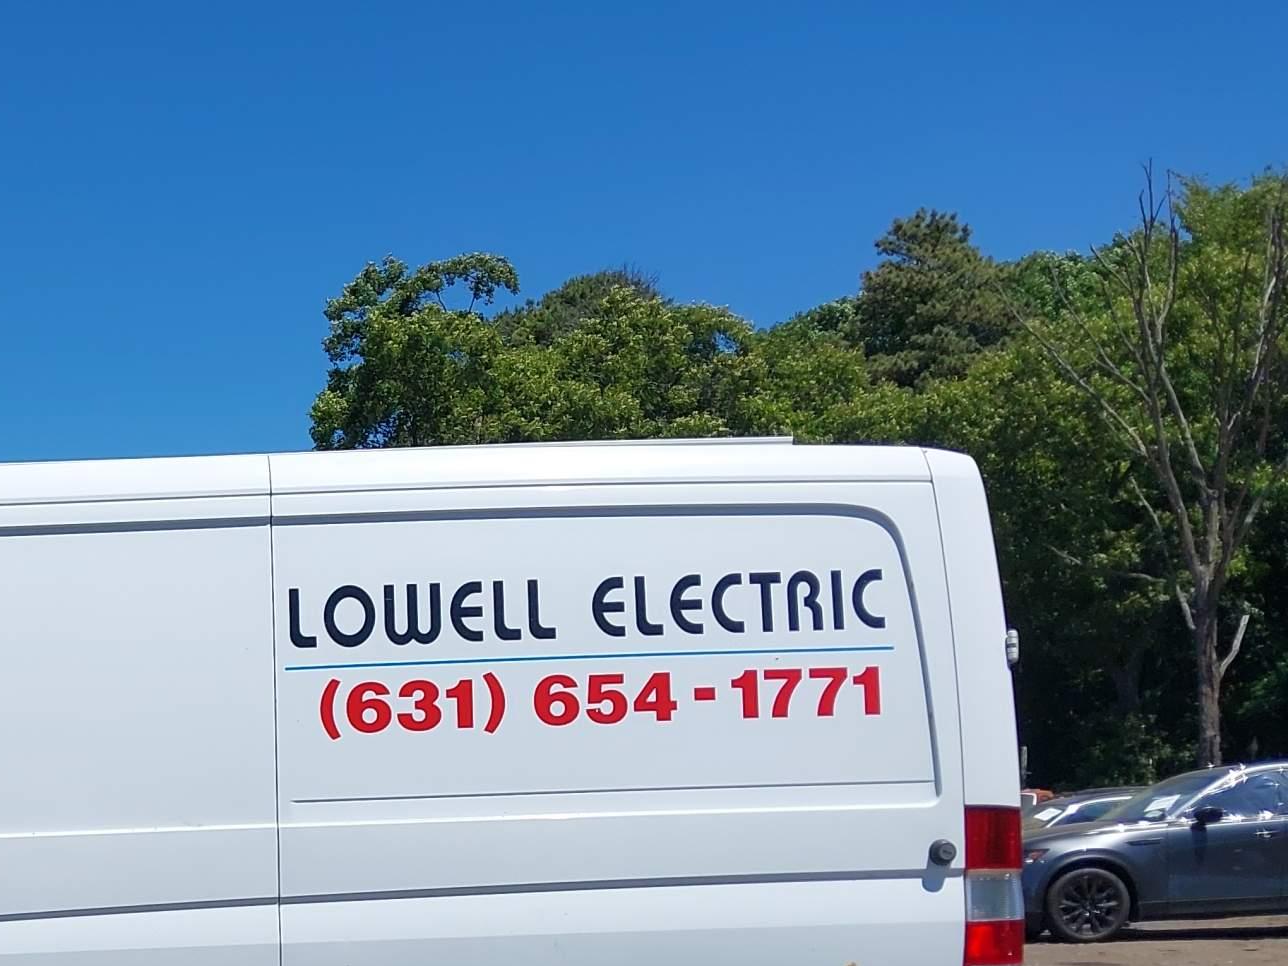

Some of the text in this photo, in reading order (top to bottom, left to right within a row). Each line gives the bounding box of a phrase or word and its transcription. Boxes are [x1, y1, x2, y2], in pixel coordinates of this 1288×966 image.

[288, 569, 886, 648] LOWELL ELECTRIC
[320, 672, 505, 740] (631)
